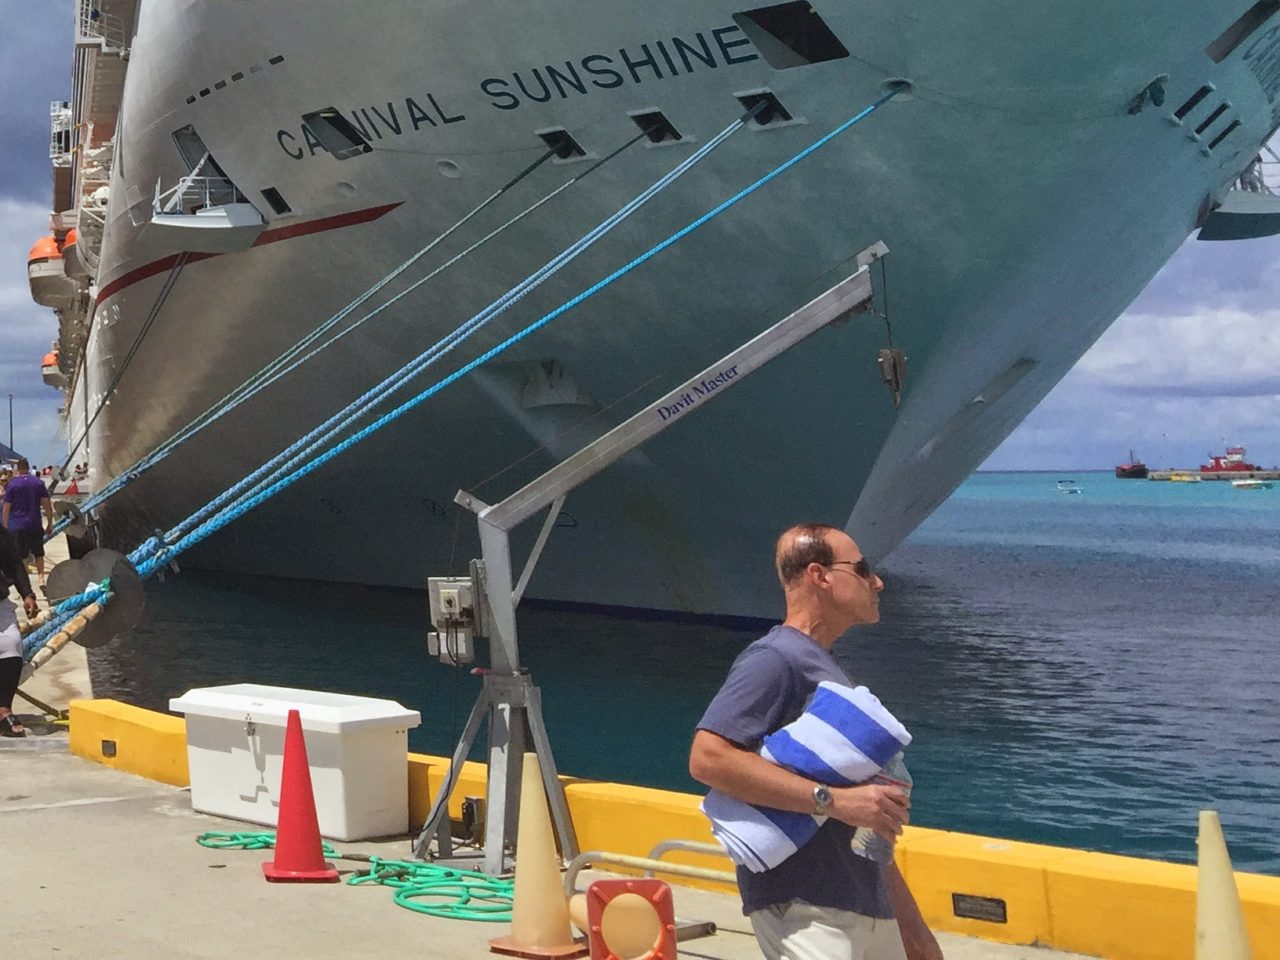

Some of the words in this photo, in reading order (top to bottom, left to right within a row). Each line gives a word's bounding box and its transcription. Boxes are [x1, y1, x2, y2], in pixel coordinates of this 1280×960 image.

[277, 93, 466, 160] CANIVAL
[480, 25, 759, 110] SUNSHINE
[657, 392, 694, 420] Davit
[692, 365, 739, 399] Master
